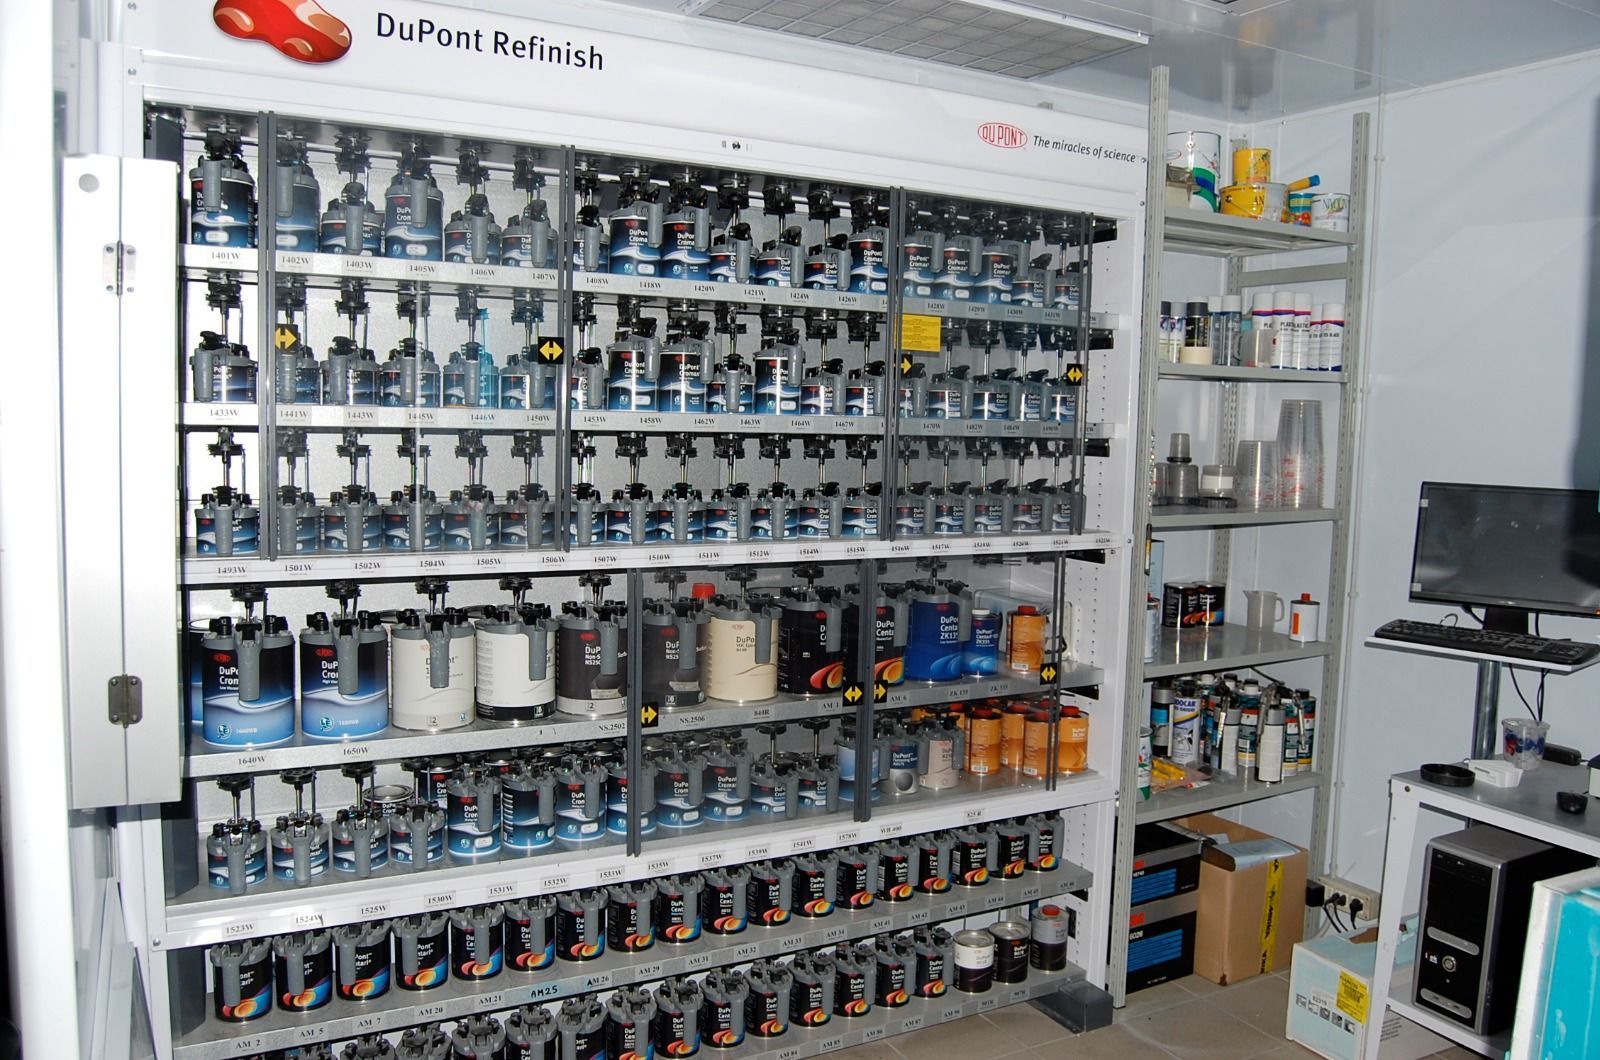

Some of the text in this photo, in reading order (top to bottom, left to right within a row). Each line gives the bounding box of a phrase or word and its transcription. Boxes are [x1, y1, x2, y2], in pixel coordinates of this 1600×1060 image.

[377, 12, 605, 71] DuPont Refinish
[1033, 135, 1136, 163] The miracles of science
[211, 251, 241, 260] 1401W
[282, 256, 311, 265] 1402W
[346, 260, 375, 269] 1403W
[409, 265, 437, 273] 1405W
[470, 268, 497, 277] 1406W
[532, 273, 557, 281] 1407W
[586, 277, 609, 285] 1408W
[639, 281, 662, 289] 1418W
[694, 285, 715, 293] 1420W
[790, 292, 809, 300] 1424W
[838, 295, 857, 303] 1426W
[209, 409, 240, 417] 1433W
[280, 410, 308, 418] 1441W
[347, 411, 375, 420] 1443W
[470, 413, 497, 422] 1446W
[526, 415, 550, 423] 1450W
[583, 416, 607, 424] 1453W
[640, 417, 662, 425] 1458W
[694, 417, 715, 425] 1462W
[740, 418, 761, 426] 1463W
[749, 550, 770, 558] 1512W
[800, 548, 820, 556] 1514W
[541, 556, 566, 564] 1506W
[594, 555, 617, 563] 1507W
[648, 553, 671, 561] 1510W
[354, 562, 383, 570] 1502W
[419, 560, 447, 568] 1504W
[477, 558, 502, 566] 1505W
[217, 566, 248, 574] 1493W
[284, 564, 314, 572] 1501W
[343, 746, 370, 756] 1650W
[238, 755, 266, 765] 1640W
[701, 854, 723, 864] 1537W
[648, 861, 669, 871] 1535W
[600, 869, 623, 879] 1533W
[543, 877, 567, 887] 1532W
[489, 885, 514, 895] 1531W
[428, 894, 453, 905] 1530W
[361, 905, 388, 915] 1525W
[226, 923, 256, 934] 1523W
[478, 997, 491, 1005] AM
[418, 1009, 433, 1017] AM
[357, 1020, 373, 1028] AM
[299, 1030, 315, 1038] AM
[235, 1041, 251, 1049] AM
